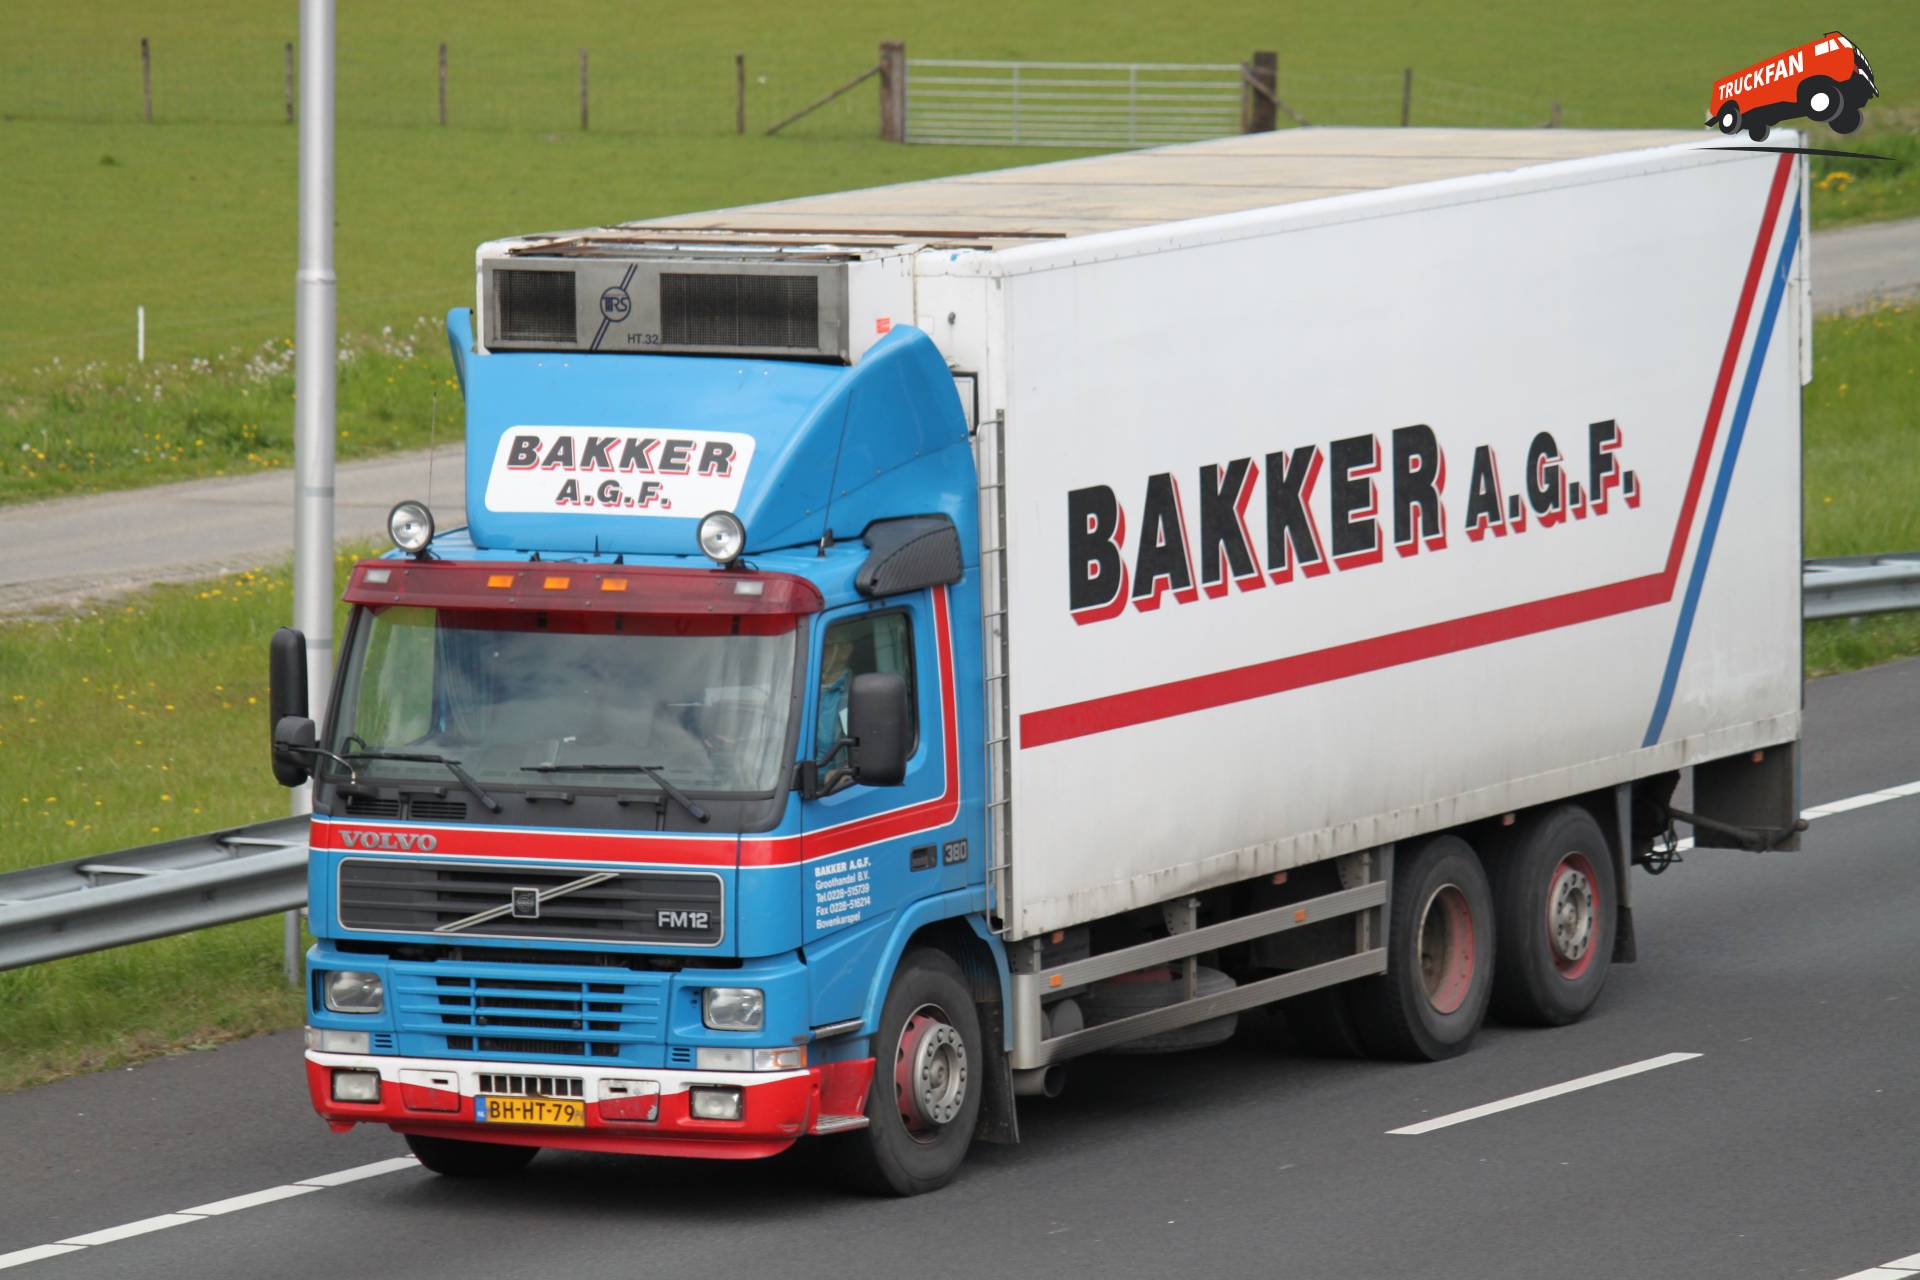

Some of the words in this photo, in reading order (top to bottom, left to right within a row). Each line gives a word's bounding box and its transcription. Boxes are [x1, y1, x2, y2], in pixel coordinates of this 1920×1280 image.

[506, 435, 737, 477] BAKKER
[554, 479, 672, 509] A.G.F.
[1067, 423, 1448, 626] BAKKER
[1464, 419, 1641, 543] A.G.F.
[338, 830, 438, 852] VOLVO
[944, 841, 967, 863] 380
[815, 861, 847, 877] BAKKER
[849, 856, 872, 871] A.G.F.
[815, 872, 856, 890] Groothandel
[857, 870, 871, 882] B.V.
[657, 911, 709, 930] FM12
[815, 905, 829, 917] Fax
[490, 1100, 575, 1122] BH-HT-79
